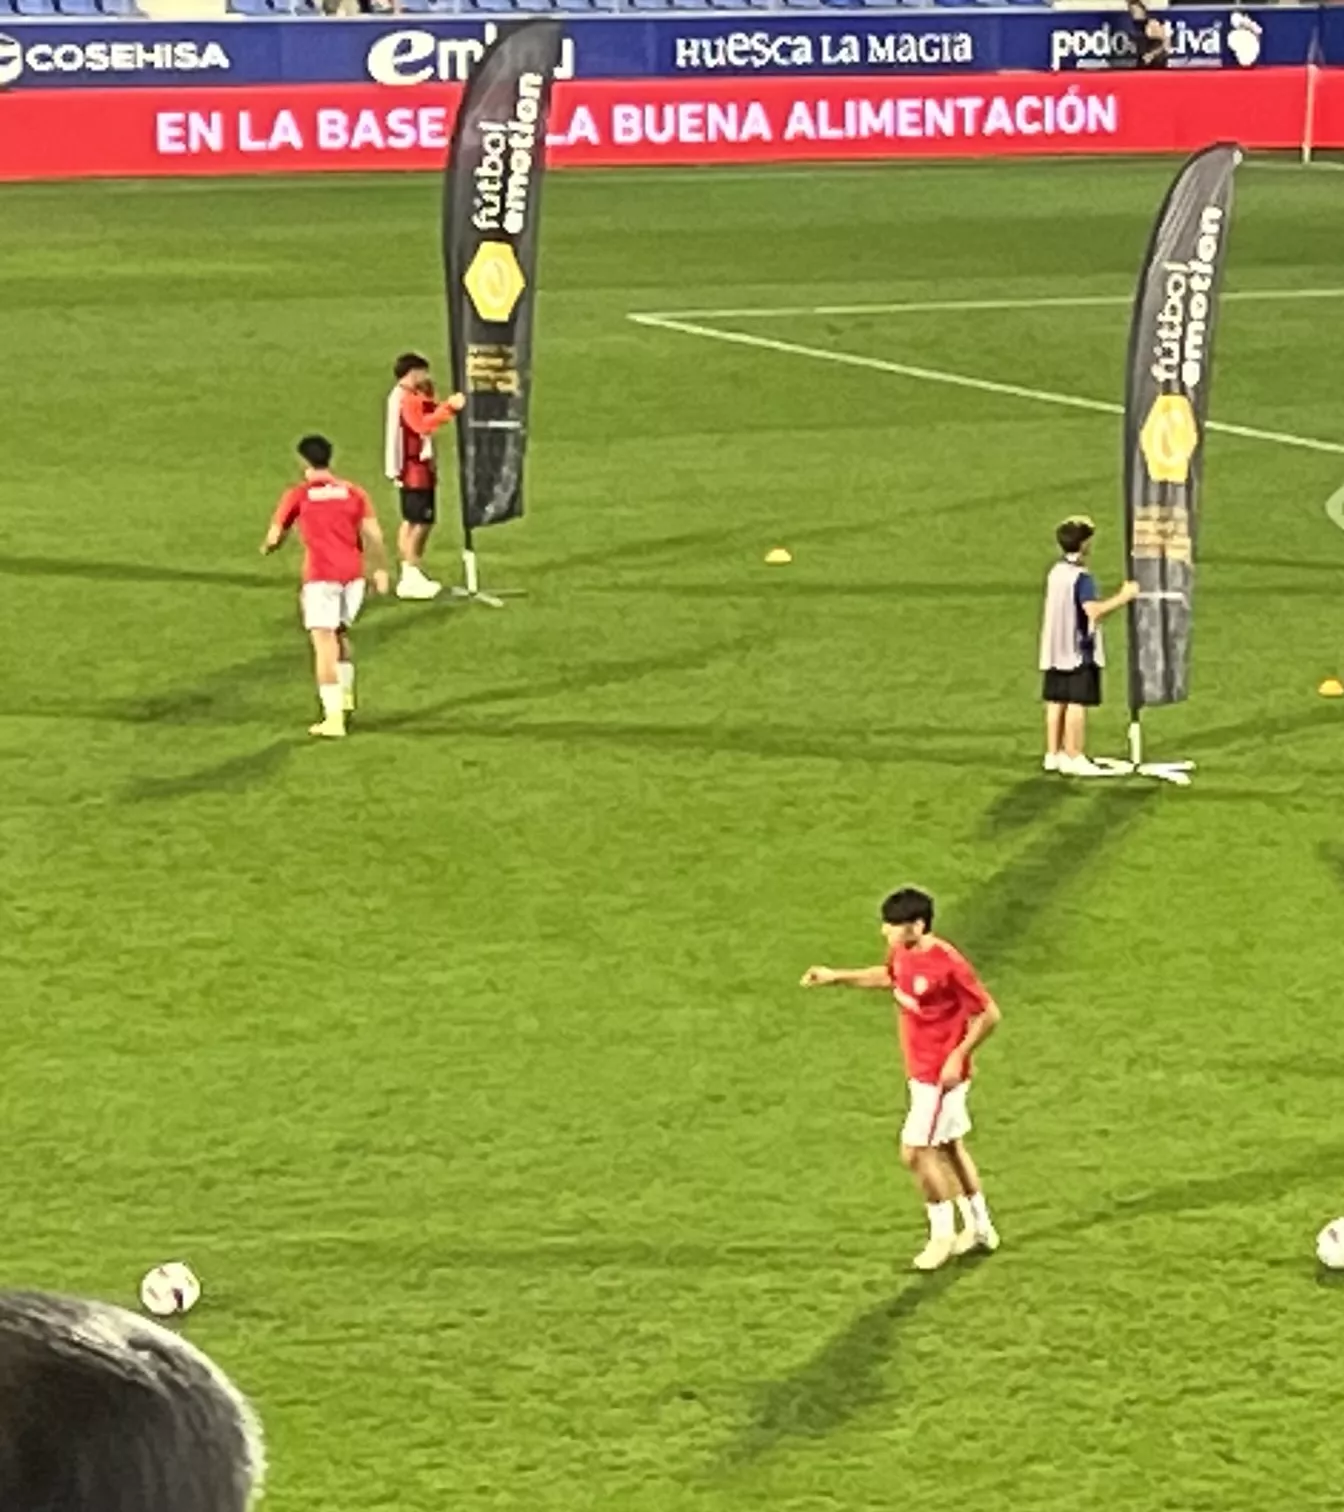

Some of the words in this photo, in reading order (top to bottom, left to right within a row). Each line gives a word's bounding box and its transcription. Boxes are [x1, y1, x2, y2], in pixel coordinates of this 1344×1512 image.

[25, 41, 230, 72] COSEHISA
[155, 110, 223, 155] EN
[237, 108, 302, 152] LA
[316, 106, 450, 151] BASE
[611, 101, 774, 145] BUENA
[783, 84, 1117, 141] ALIMENTACIÓN
[502, 71, 543, 234] emotion
[1181, 204, 1222, 387] emotion
